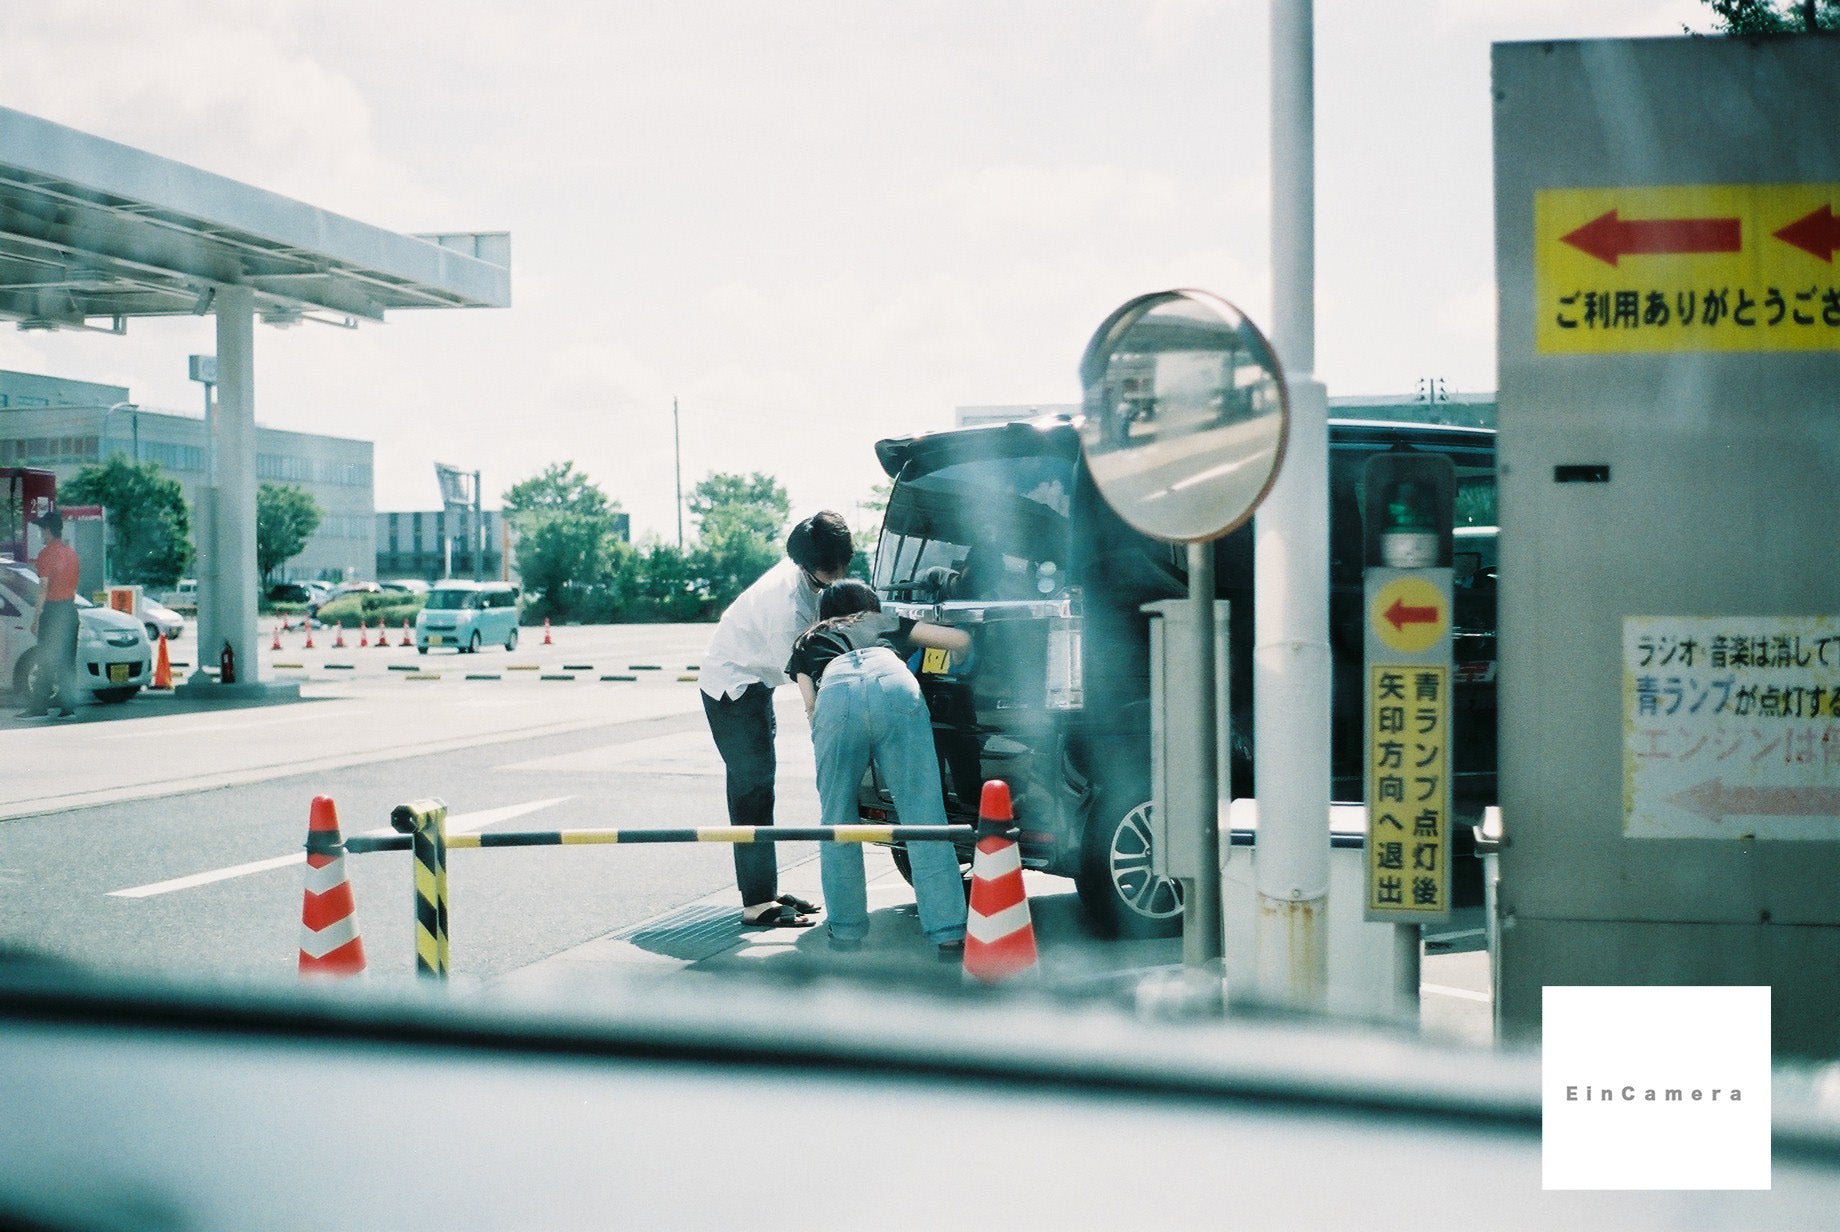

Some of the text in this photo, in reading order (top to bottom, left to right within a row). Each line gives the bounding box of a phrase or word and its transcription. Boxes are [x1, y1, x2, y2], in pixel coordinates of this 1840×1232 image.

[1377, 673, 1405, 905] 矢印方向へ退出
